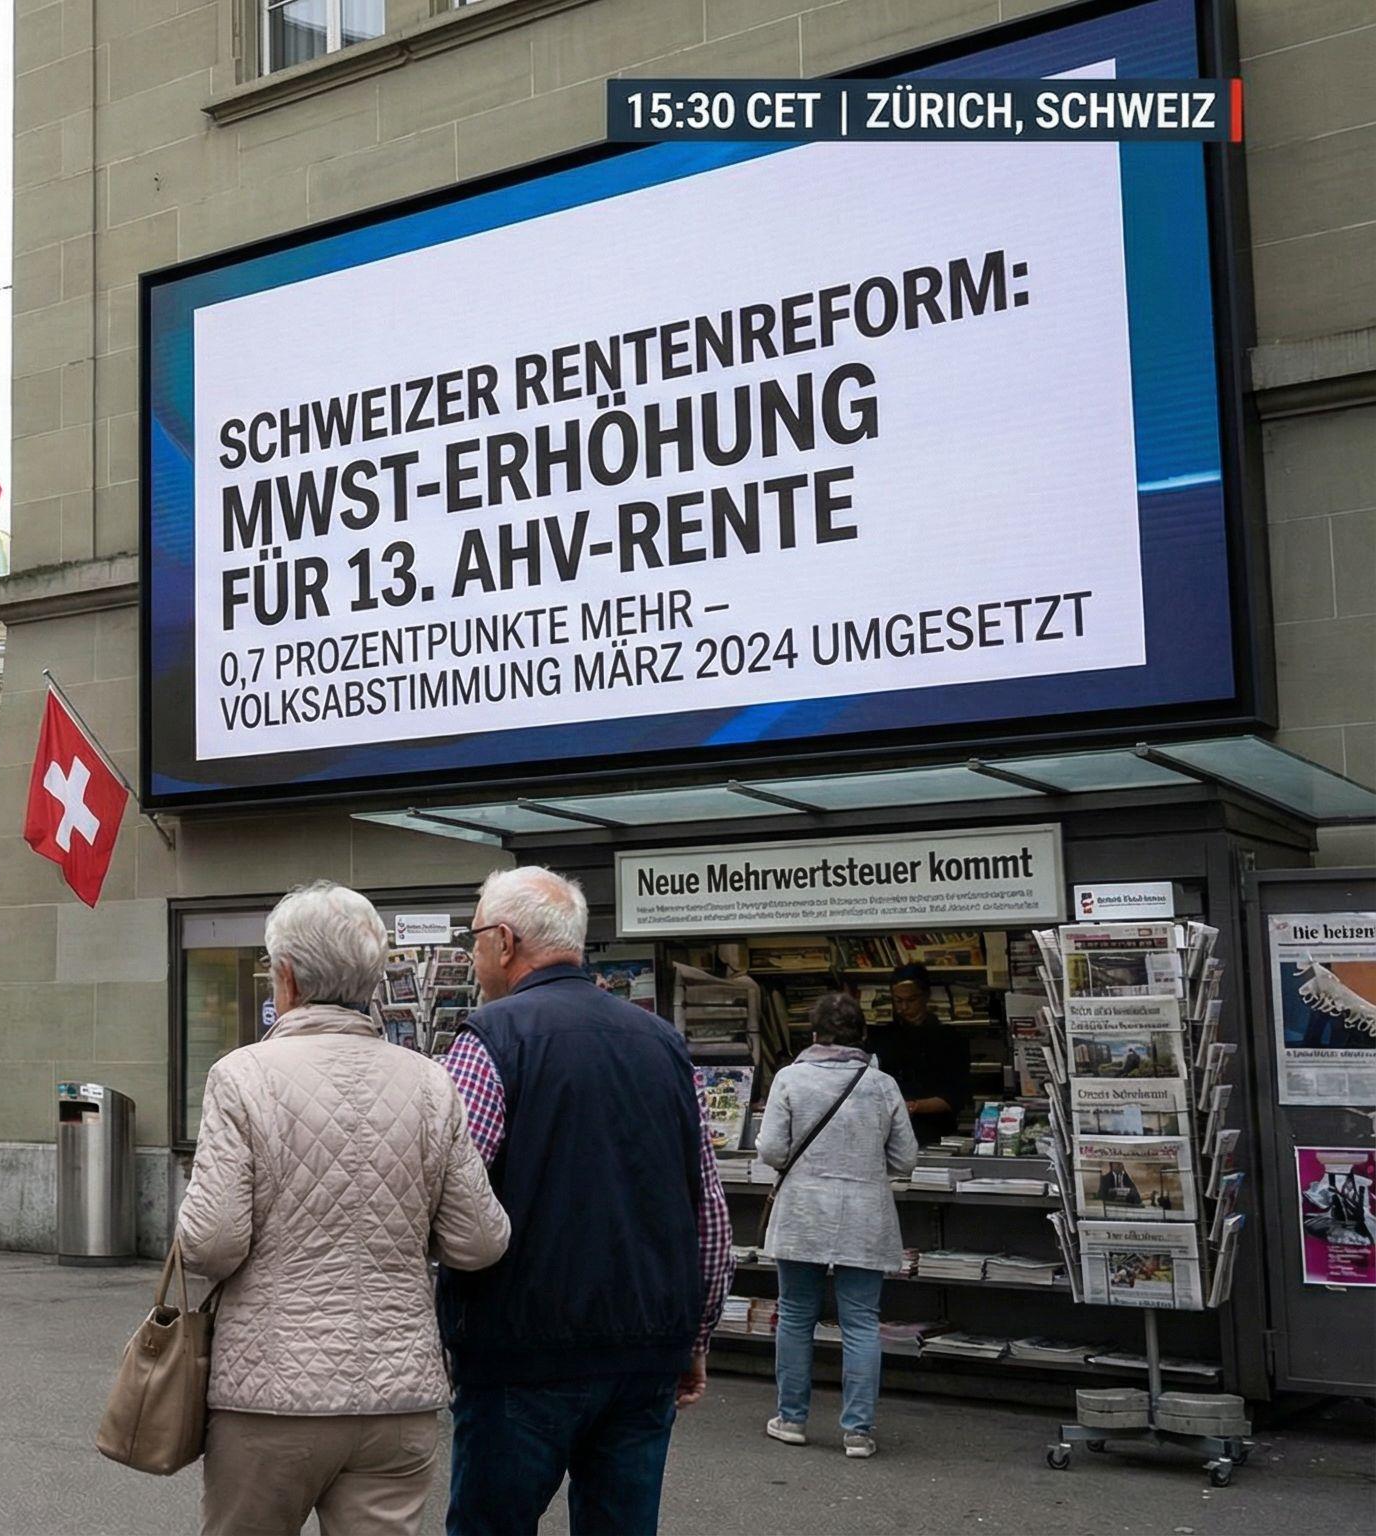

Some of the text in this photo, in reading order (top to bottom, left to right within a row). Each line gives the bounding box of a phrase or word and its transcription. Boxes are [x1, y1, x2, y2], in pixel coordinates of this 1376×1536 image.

[219, 249, 1029, 470] SCHWEIZER RENTENREFORM:
[222, 362, 879, 553] MWST-ERHÖHUNG
[222, 465, 858, 631] FÜR 13. AHV-RENTE
[220, 647, 265, 691] 0,7
[276, 605, 570, 680] PROZENTPUNKTE
[581, 589, 693, 641] MEHR
[220, 590, 1092, 731] VOLKSABSTIMMUNG MÄRZ 2024 UMGESETZT
[637, 846, 1034, 897] Neue Mehrwertsteuer kommt
